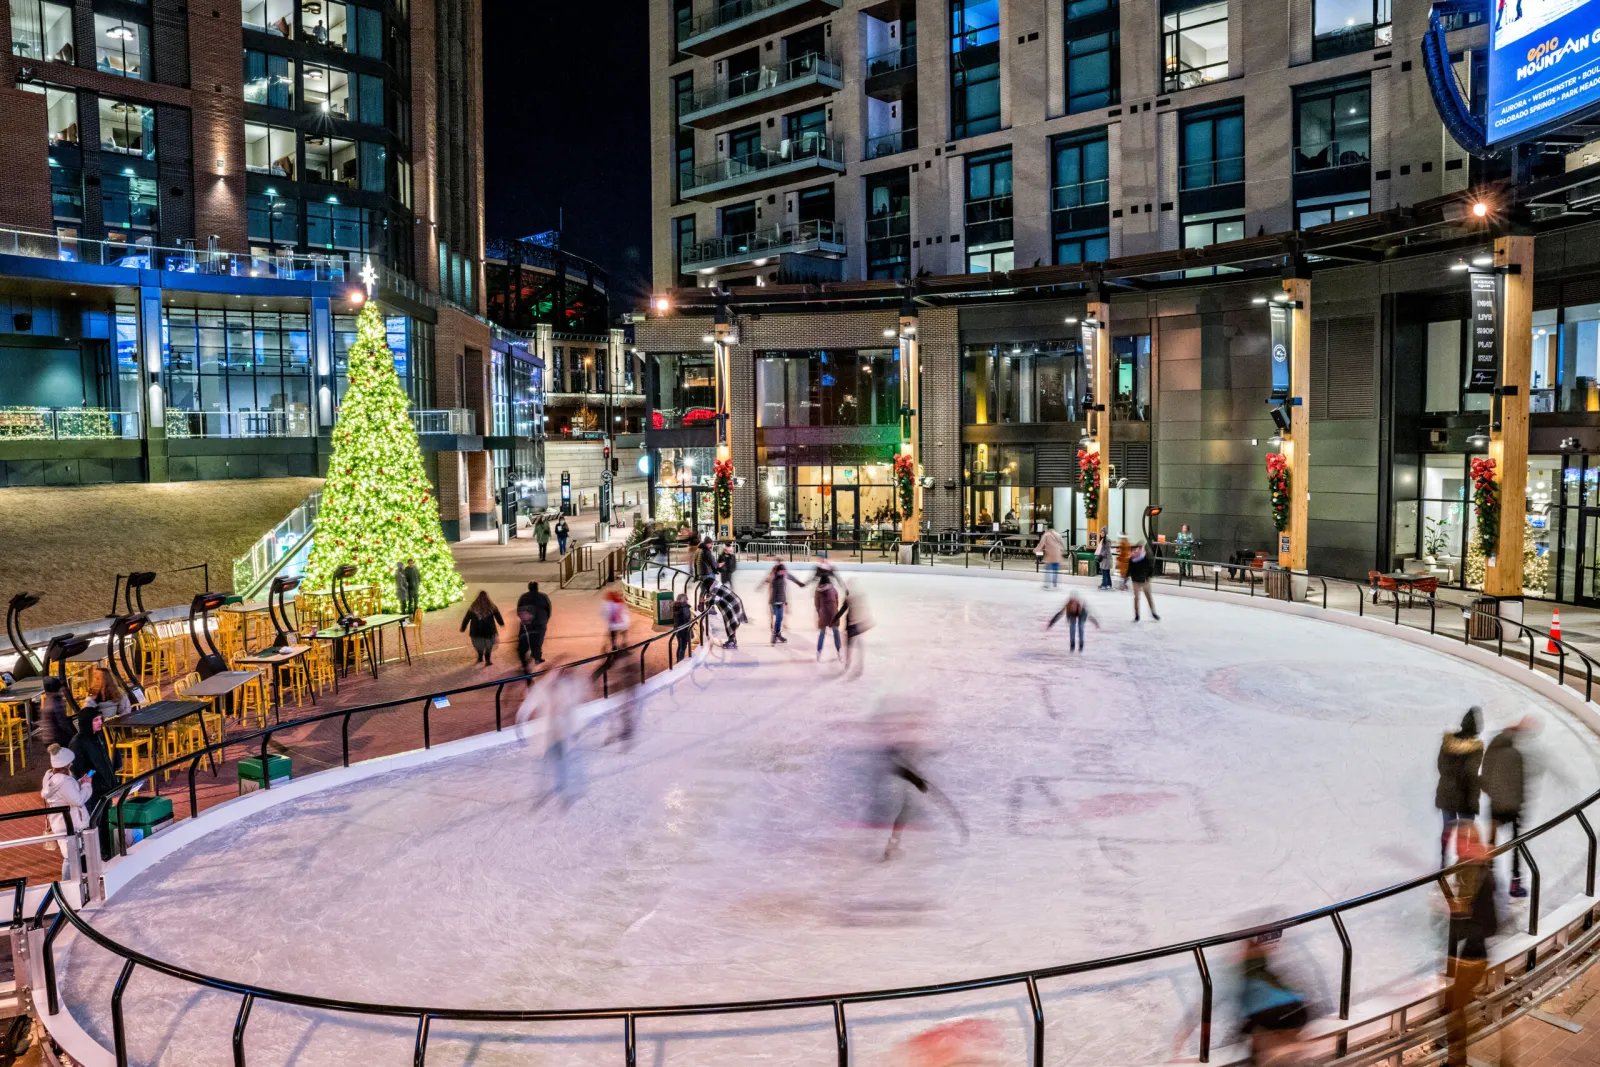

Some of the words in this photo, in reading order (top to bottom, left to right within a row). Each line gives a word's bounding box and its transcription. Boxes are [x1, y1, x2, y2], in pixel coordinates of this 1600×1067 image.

[1517, 34, 1589, 81] MOUNTAIN
[1527, 37, 1559, 63] epic
[1495, 109, 1529, 127] COLORADO
[1529, 97, 1556, 114] SPRINGS
[1561, 86, 1579, 100] PARK
[1501, 98, 1527, 115] AURORA
[1532, 76, 1577, 102] WESTMINSTER
[1476, 327, 1494, 335] SHOP
[1478, 313, 1493, 321] LIVE
